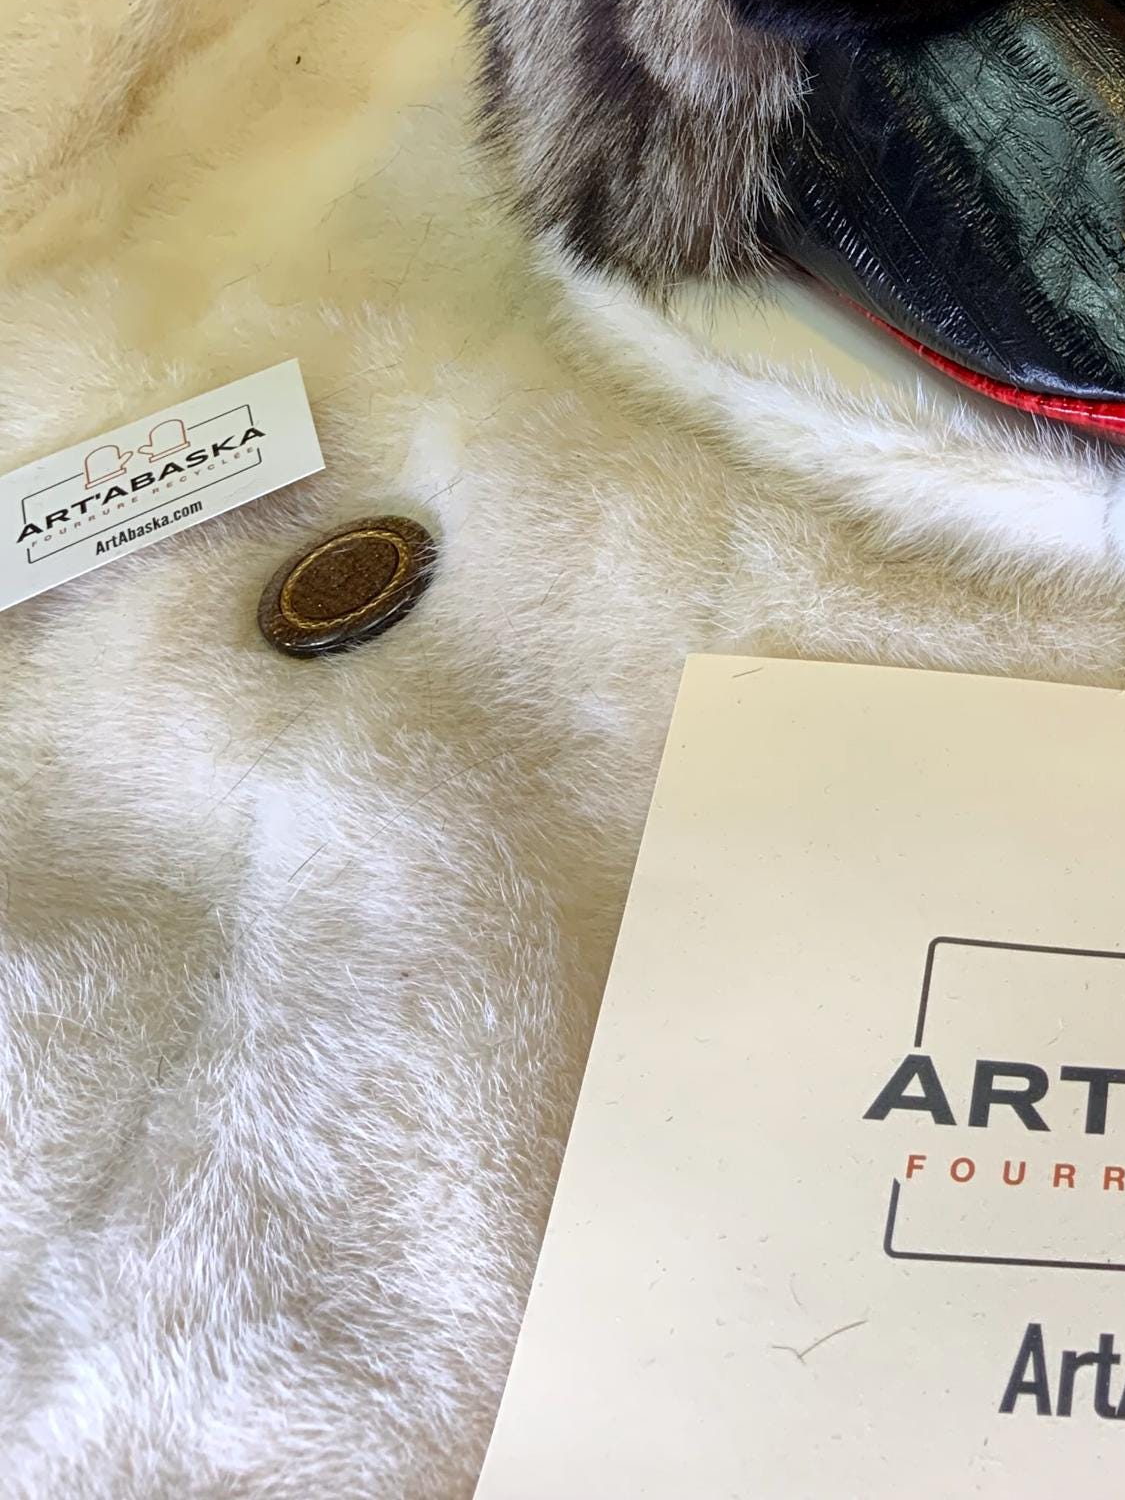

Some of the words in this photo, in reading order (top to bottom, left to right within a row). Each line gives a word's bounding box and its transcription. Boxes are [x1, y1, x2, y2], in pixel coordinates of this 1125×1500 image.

[16, 426, 266, 544] ART'ABASKA
[31, 496, 139, 548] FOURRURE
[95, 500, 204, 555] ArtAbaska.com
